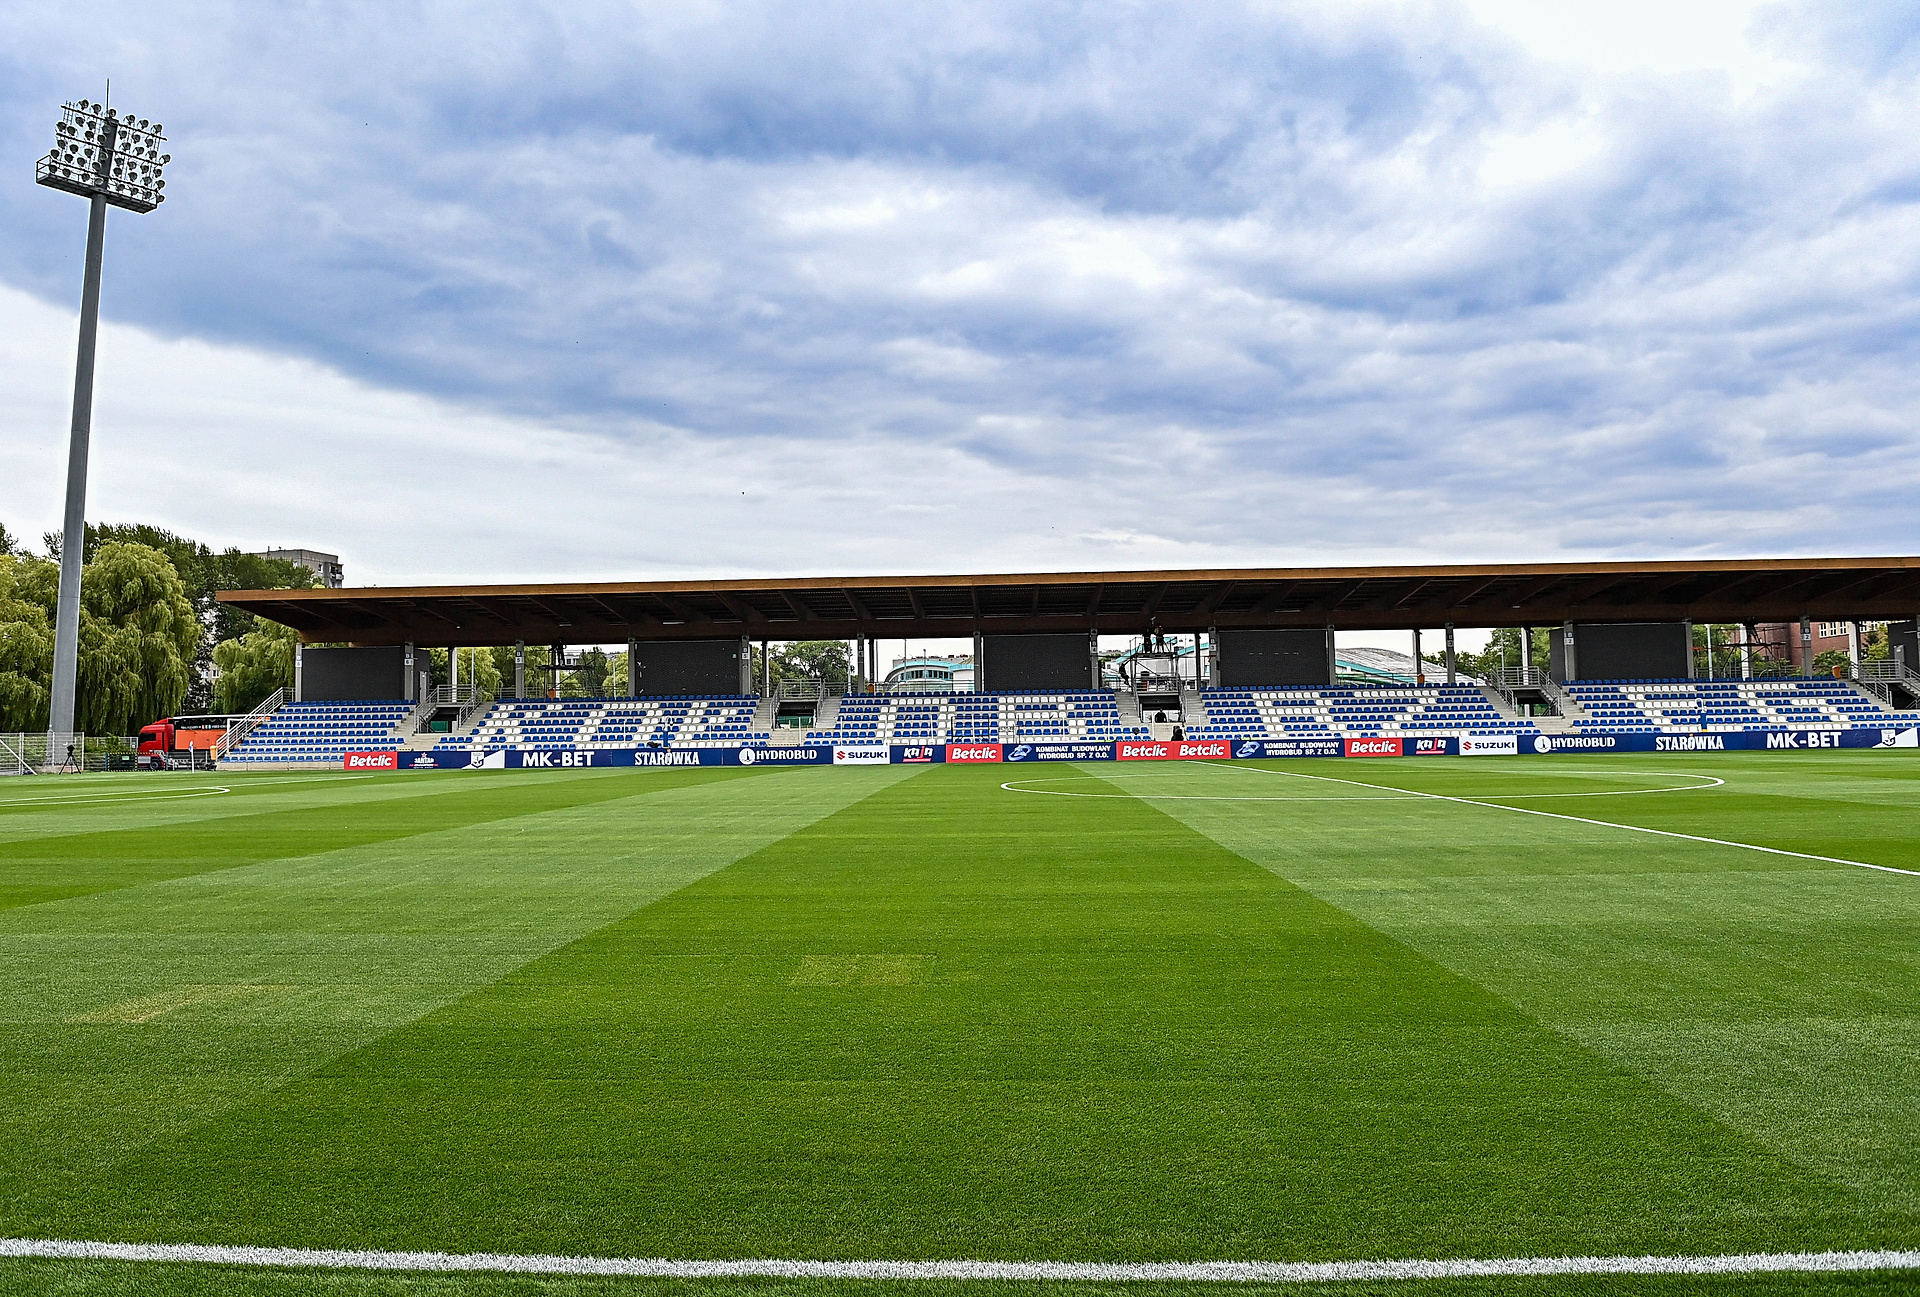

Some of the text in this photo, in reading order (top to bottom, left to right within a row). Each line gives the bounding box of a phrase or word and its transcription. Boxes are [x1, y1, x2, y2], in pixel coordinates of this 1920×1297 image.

[1299, 741, 1339, 749] BUDOWLANY
[1474, 741, 1515, 750] SUZUKI
[1552, 737, 1616, 748] HYDROBUD
[1655, 734, 1725, 751] STARÓWKA
[1766, 731, 1843, 749] MK-BET
[1122, 745, 1168, 757] Betclic
[1179, 744, 1225, 757] Betclic
[1350, 740, 1397, 753] Betclic
[522, 751, 595, 768] MK-BET
[634, 749, 700, 766] STARÓWKA
[756, 749, 817, 760] HYDROBUD
[848, 751, 888, 759] SUZUKI
[951, 747, 997, 760] Betclic
[349, 755, 393, 767] Betclic
